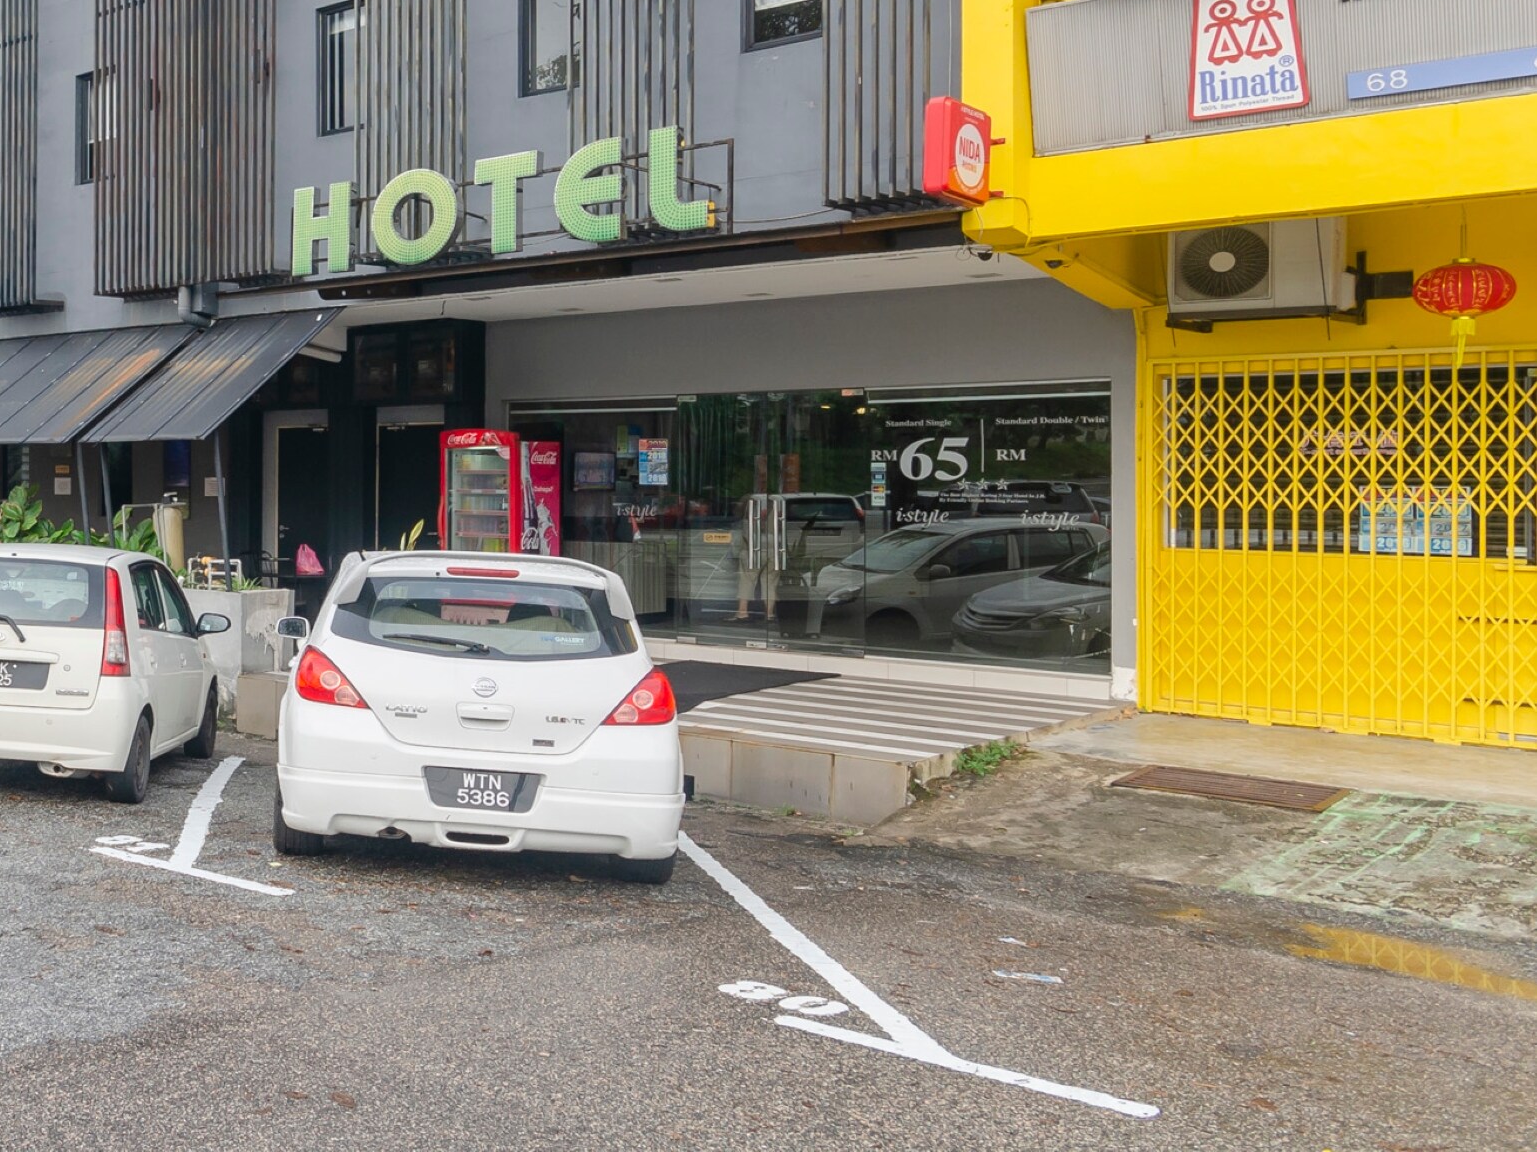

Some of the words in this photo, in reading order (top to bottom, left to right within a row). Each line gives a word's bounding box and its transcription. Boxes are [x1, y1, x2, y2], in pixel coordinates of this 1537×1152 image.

[1198, 64, 1299, 104] Rinata
[1367, 69, 1408, 92] 68
[959, 136, 981, 163] NIDA
[291, 125, 710, 277] HOTEL
[885, 419, 923, 427] Standard
[925, 419, 952, 428] Single
[995, 416, 1038, 425] Standard
[1039, 416, 1074, 424] Double
[1080, 415, 1106, 424] Twin
[871, 450, 898, 461] RM
[900, 437, 970, 481] 65
[996, 449, 1026, 461] RM
[462, 772, 502, 790] WTN
[456, 789, 510, 808] 5386
